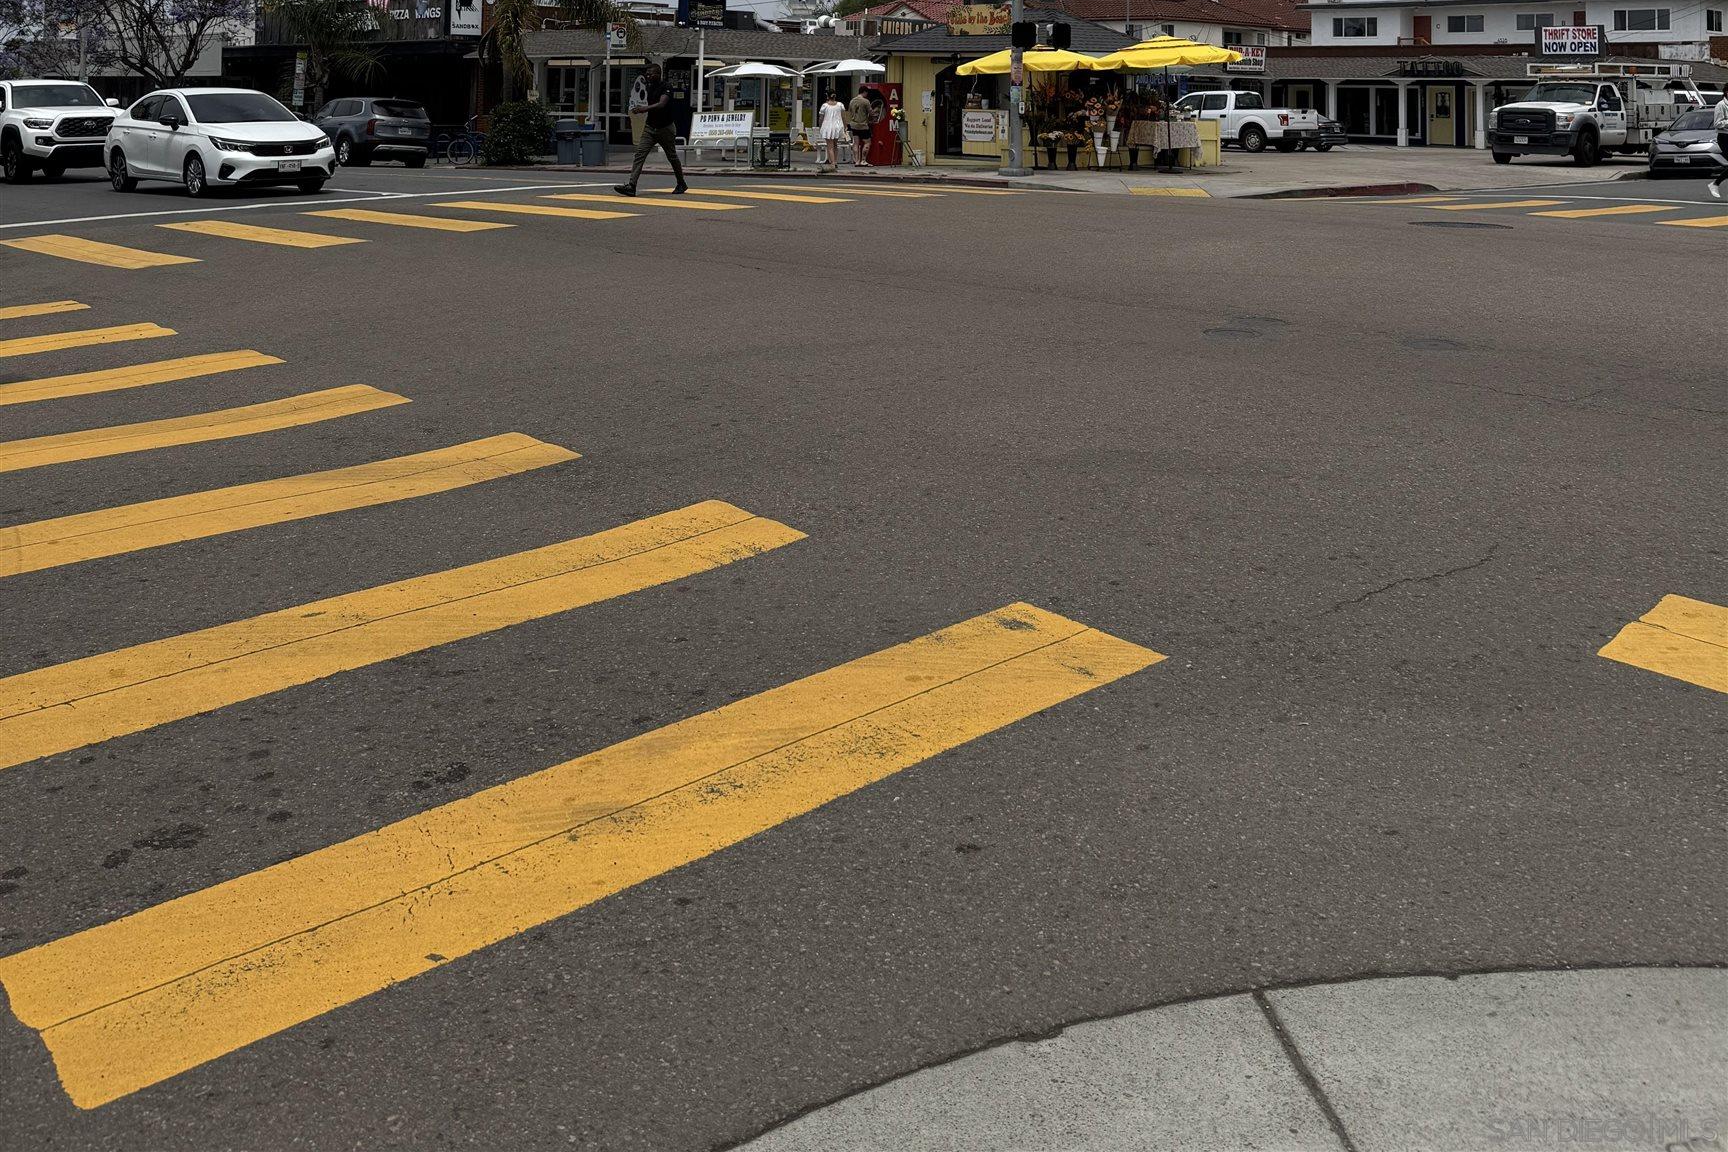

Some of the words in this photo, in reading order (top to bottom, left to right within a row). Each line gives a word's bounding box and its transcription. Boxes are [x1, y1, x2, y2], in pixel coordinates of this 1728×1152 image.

[1543, 28, 1570, 40] THRIFT
[1572, 28, 1597, 40] STORE
[1544, 41, 1568, 53] NOW
[1570, 41, 1597, 53] OPEN
[1397, 60, 1463, 76] TATTOO
